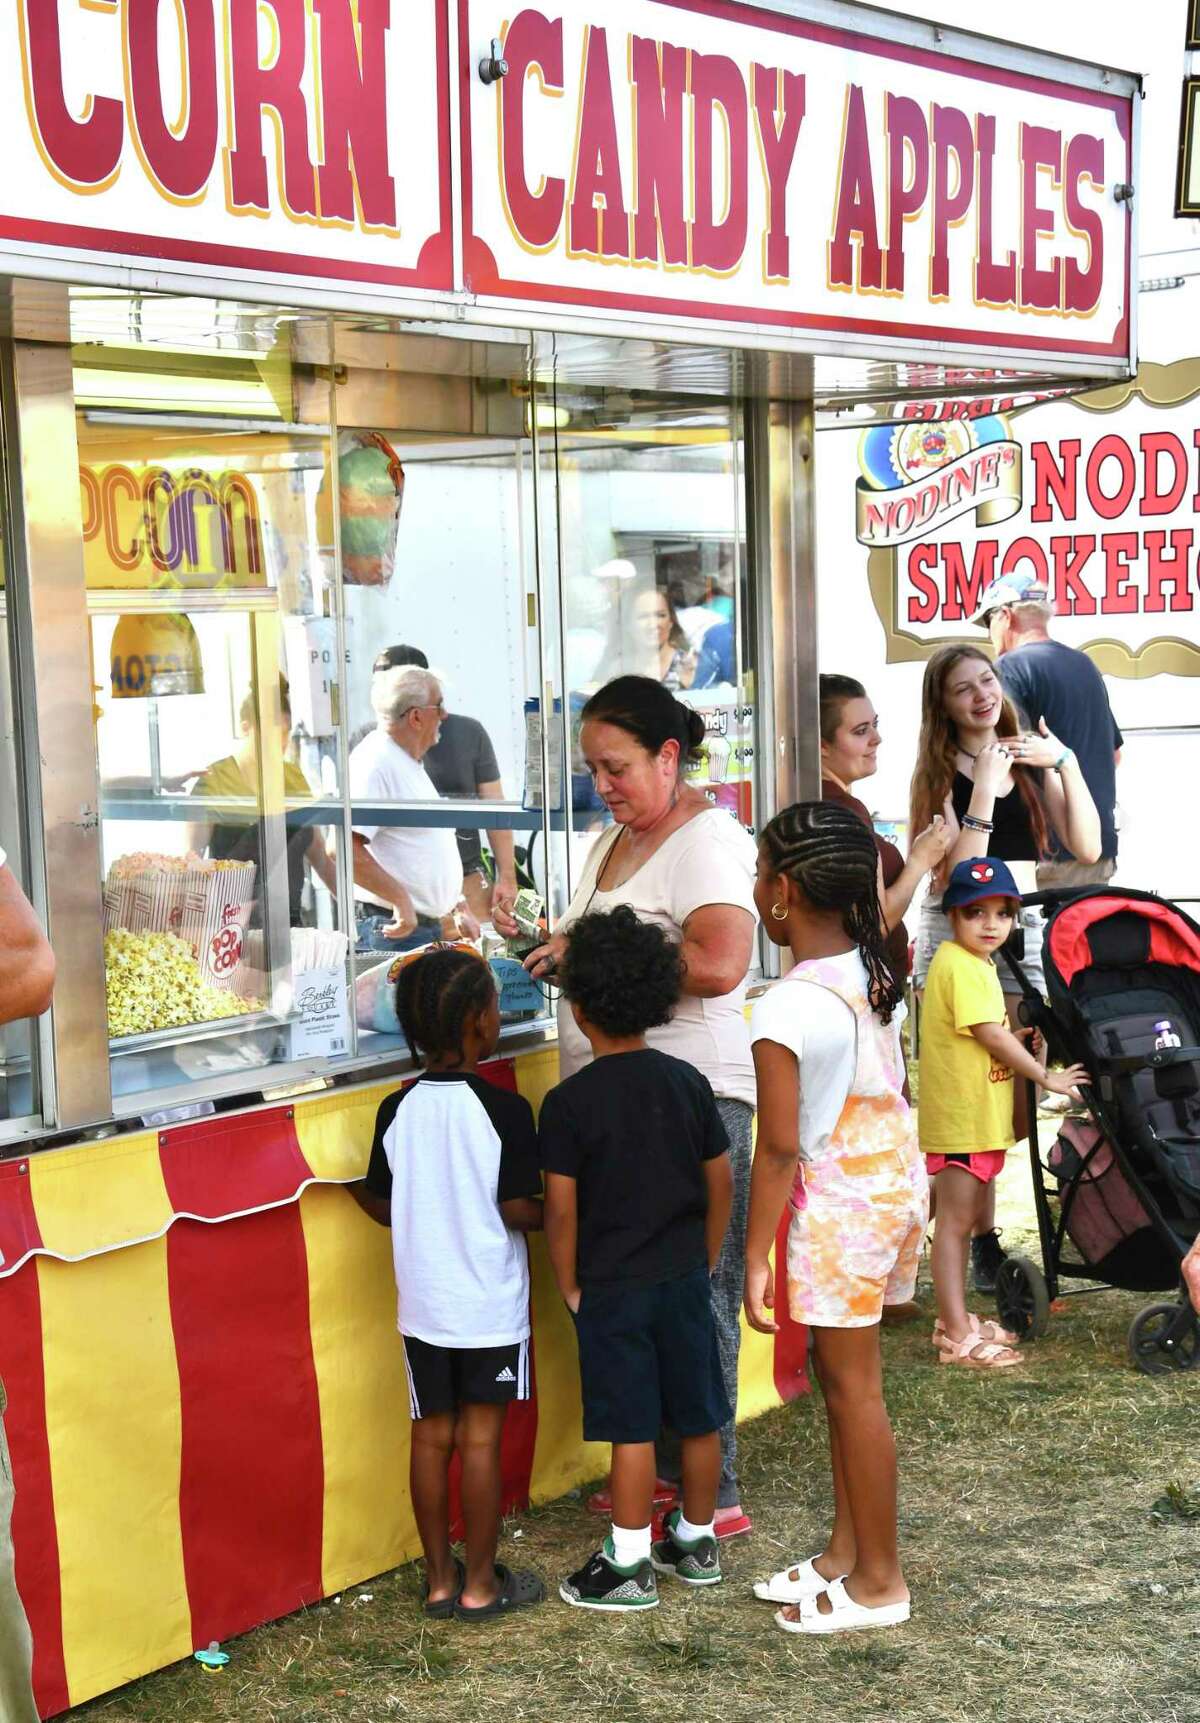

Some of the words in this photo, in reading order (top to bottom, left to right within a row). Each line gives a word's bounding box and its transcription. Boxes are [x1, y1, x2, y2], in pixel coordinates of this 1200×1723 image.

[17, 0, 401, 238] CORN
[498, 8, 806, 287] CANDY
[826, 81, 1106, 320] APPLES
[311, 650, 351, 663] POE
[907, 528, 1200, 624] SMOKEH
